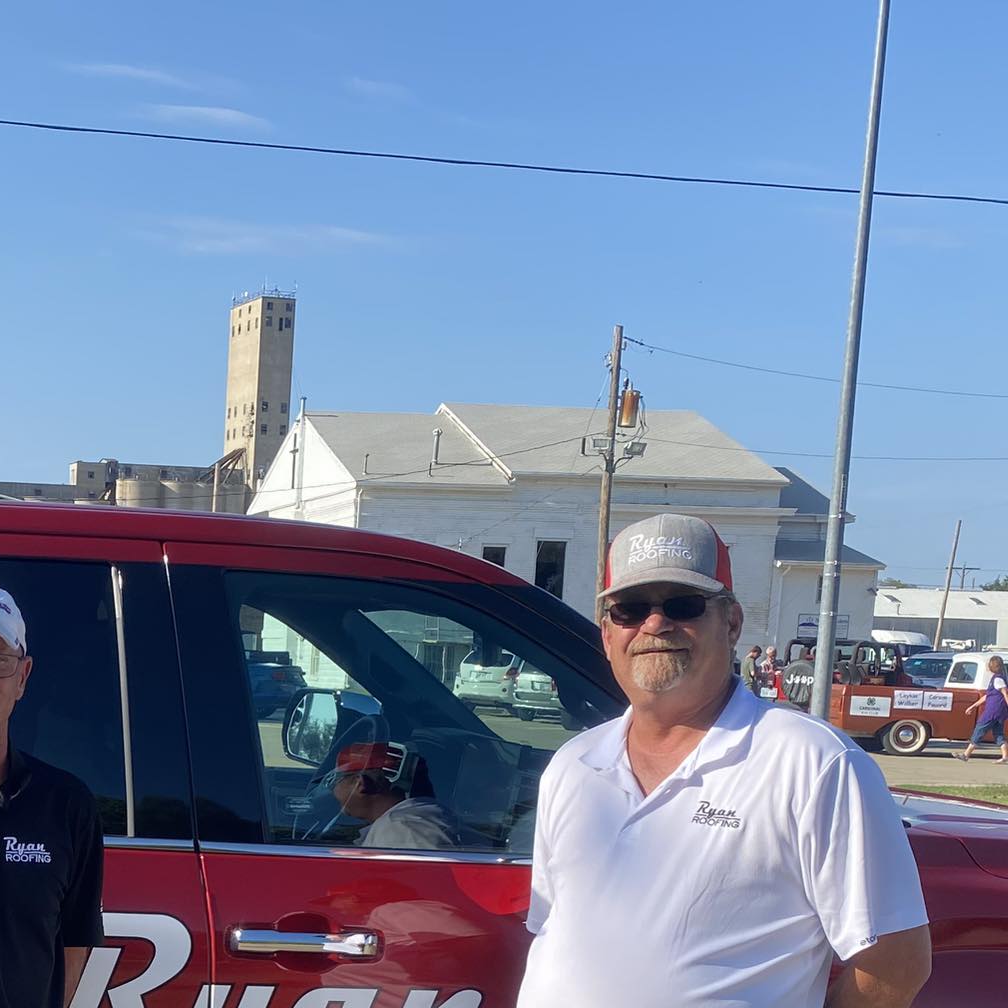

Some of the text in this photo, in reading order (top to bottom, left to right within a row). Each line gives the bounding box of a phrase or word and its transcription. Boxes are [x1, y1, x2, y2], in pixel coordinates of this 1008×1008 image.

[629, 533, 684, 551] Ryan
[628, 549, 693, 565] ROOFING
[697, 800, 737, 820] Ryan
[691, 816, 741, 829] ROOFING
[3, 836, 46, 855] Ryan
[5, 853, 52, 863] ROOFING
